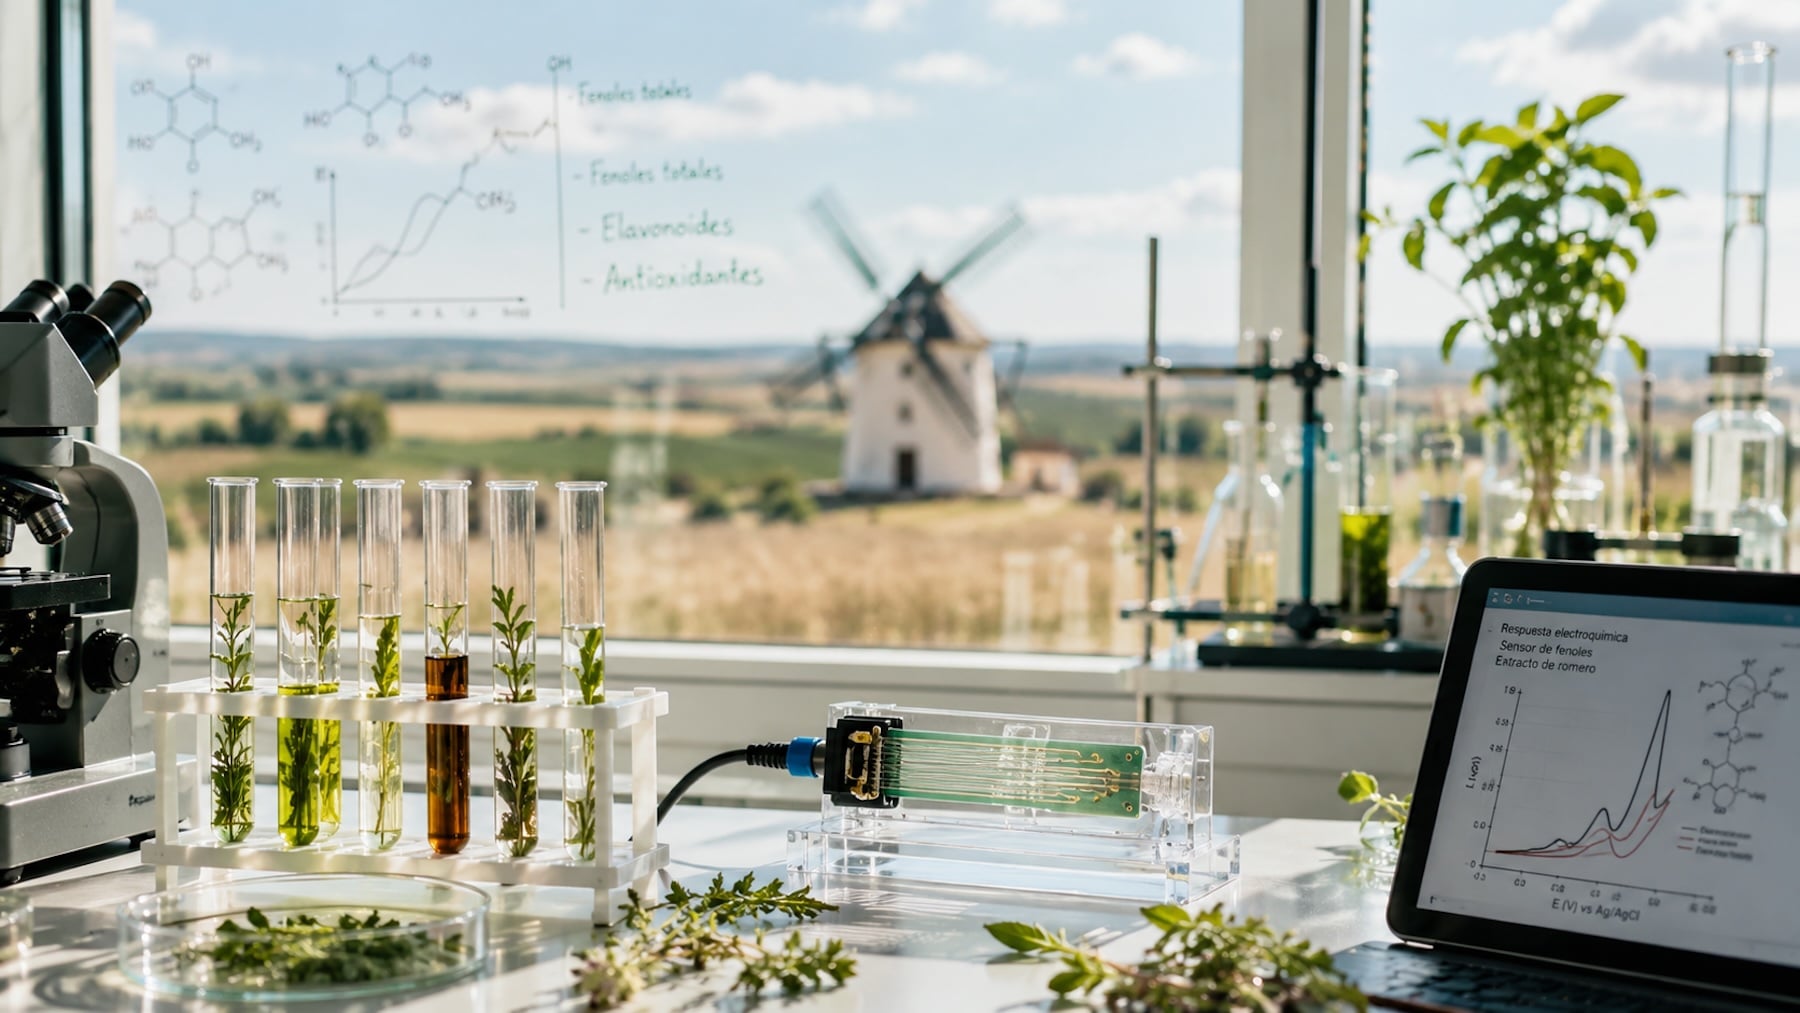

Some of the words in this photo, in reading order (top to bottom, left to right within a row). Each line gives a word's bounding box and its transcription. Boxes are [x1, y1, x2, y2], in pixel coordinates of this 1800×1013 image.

[578, 80, 634, 105] Fenoles
[590, 158, 655, 186] Fenoles
[663, 158, 723, 181] totales
[604, 257, 764, 294] Antioxidantes
[1501, 623, 1552, 637] Respuesta
[1499, 640, 1536, 653] Sensor
[1539, 643, 1553, 655] de
[1555, 645, 1593, 658] fenoles
[1541, 659, 1555, 670] de
[1557, 662, 1596, 674] romero
[1551, 898, 1560, 910] E
[1562, 900, 1578, 914] (V)
[1580, 904, 1592, 914] vs
[1595, 904, 1641, 922] Ag/AgCl
